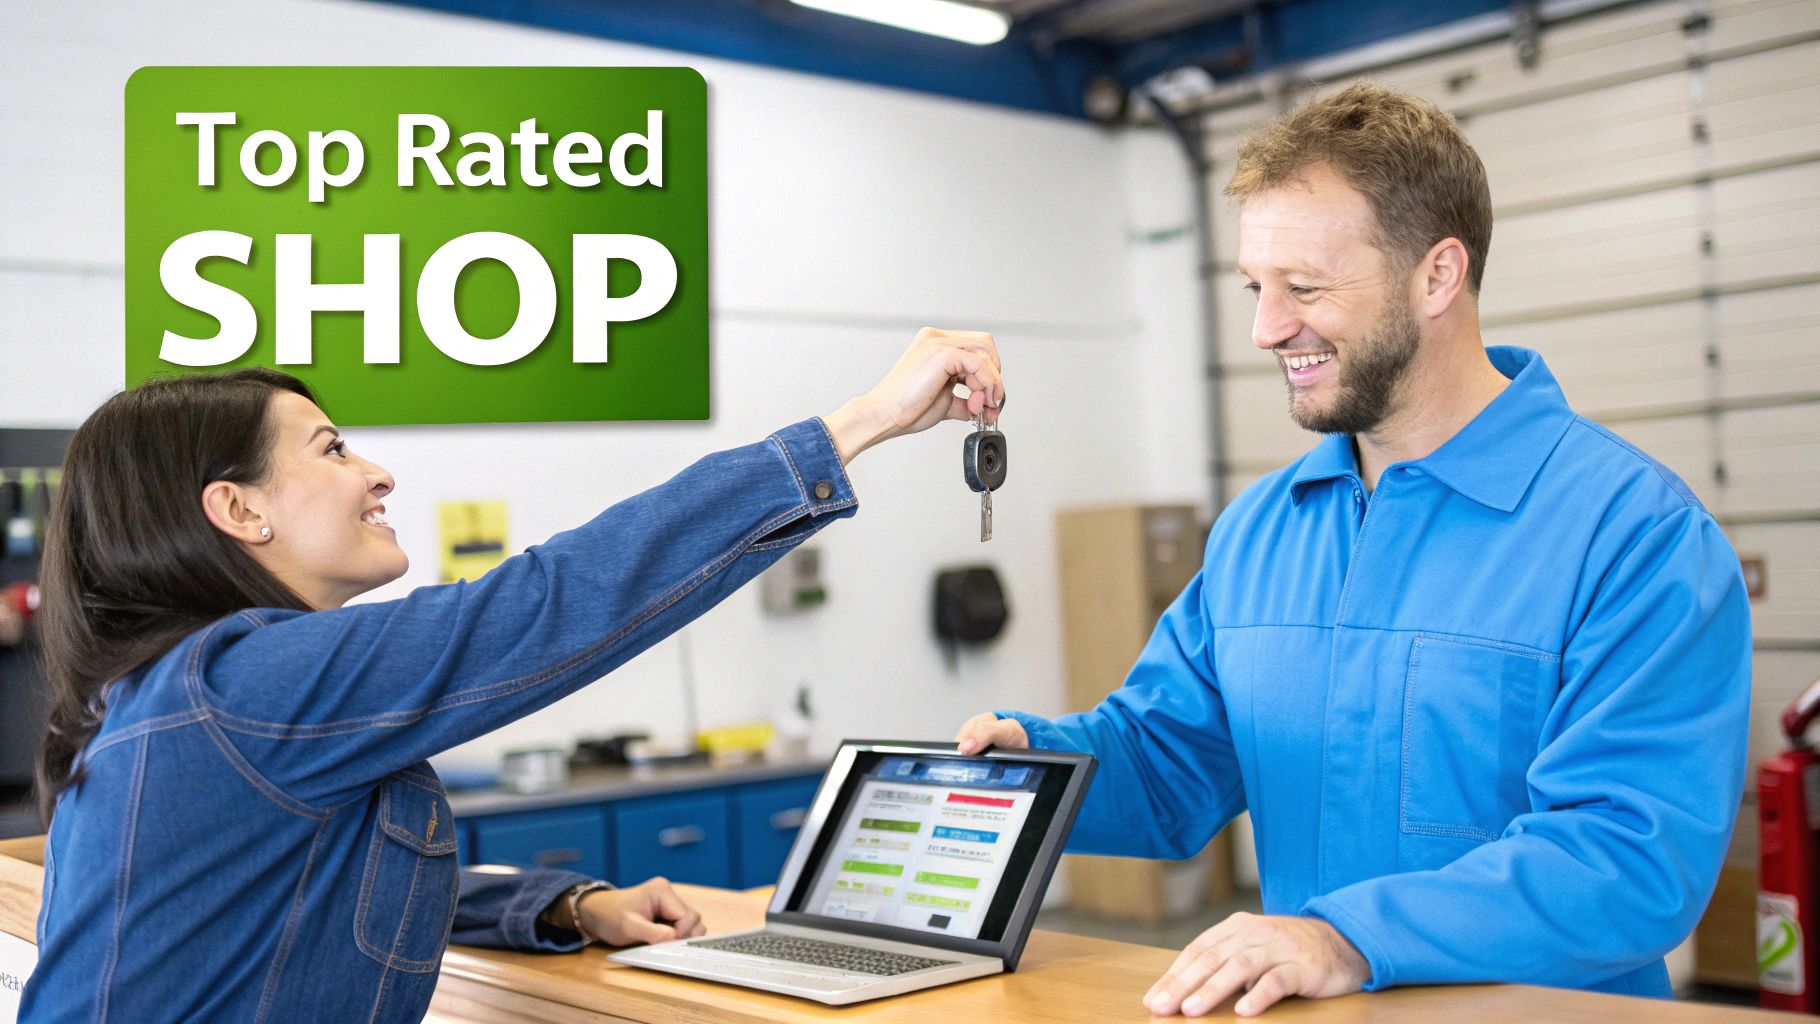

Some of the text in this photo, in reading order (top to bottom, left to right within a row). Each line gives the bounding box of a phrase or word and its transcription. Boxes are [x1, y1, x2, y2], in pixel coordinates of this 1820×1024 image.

[175, 109, 663, 203] Top Rated
[158, 229, 678, 367] SHOP
